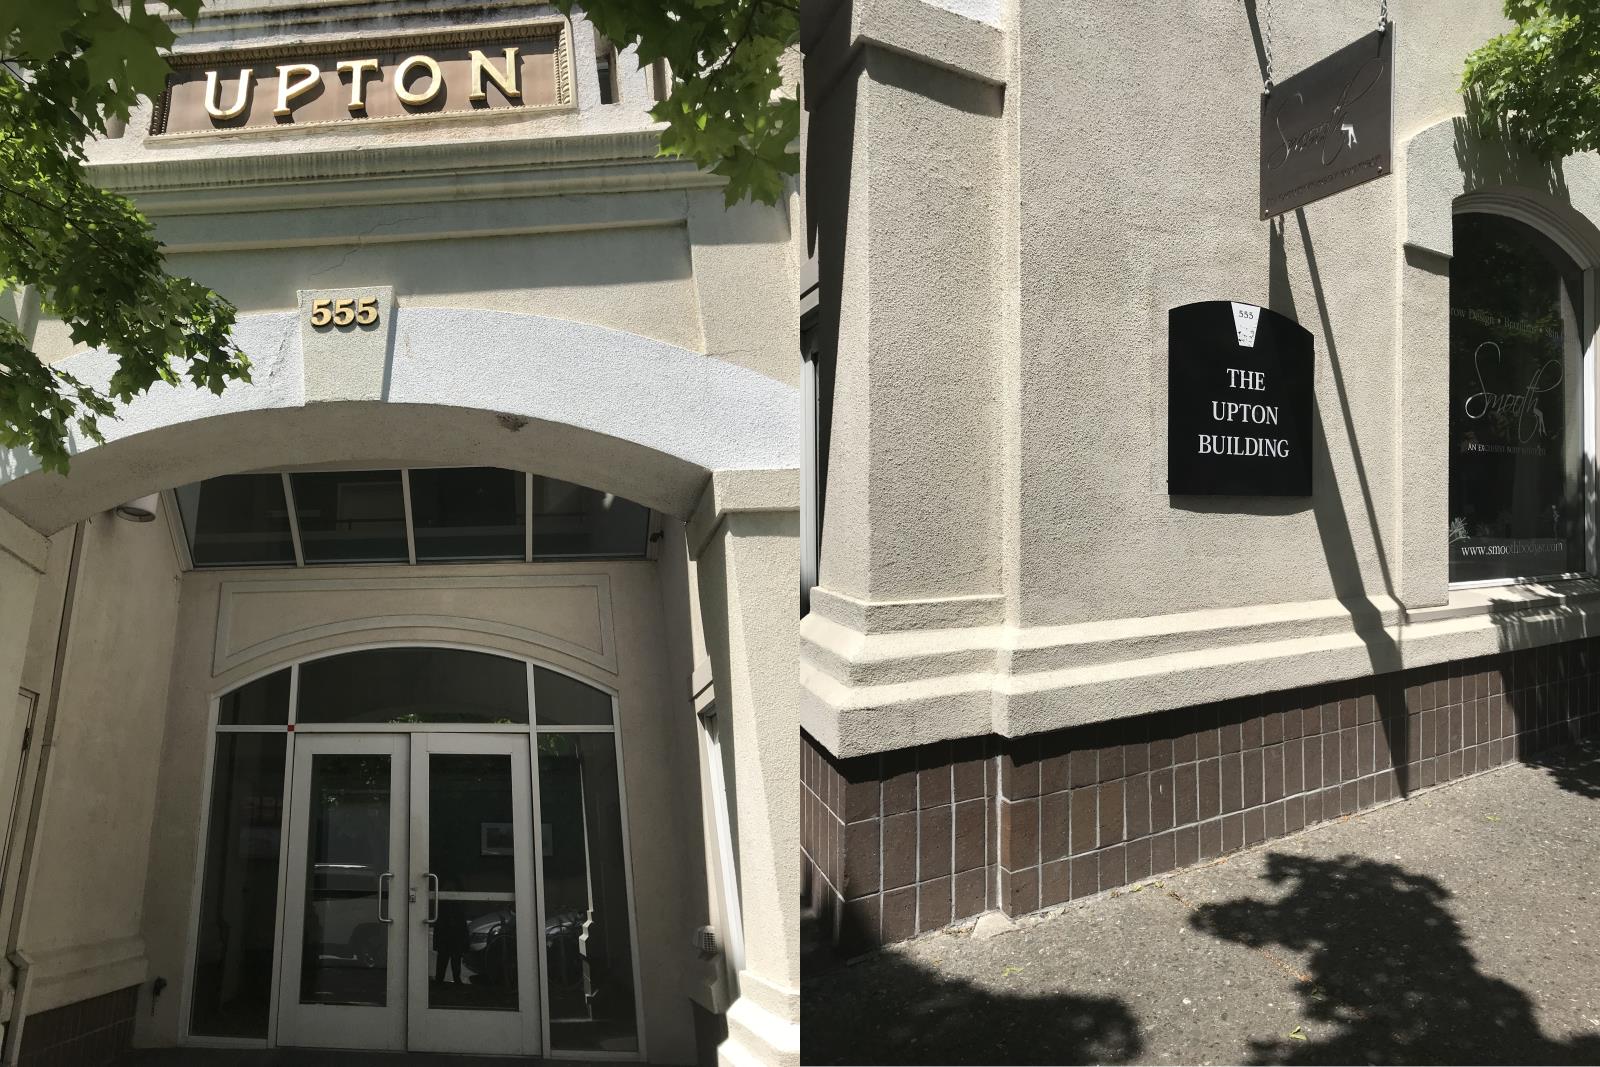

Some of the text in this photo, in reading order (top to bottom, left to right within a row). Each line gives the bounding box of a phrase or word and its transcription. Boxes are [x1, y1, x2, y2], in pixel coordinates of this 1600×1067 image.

[204, 47, 522, 121] UPTON
[310, 296, 379, 328] 555
[1238, 310, 1254, 320] 555
[1226, 368, 1266, 391] THE
[1211, 400, 1279, 426] UPTON
[1198, 434, 1290, 458] BUILDING
